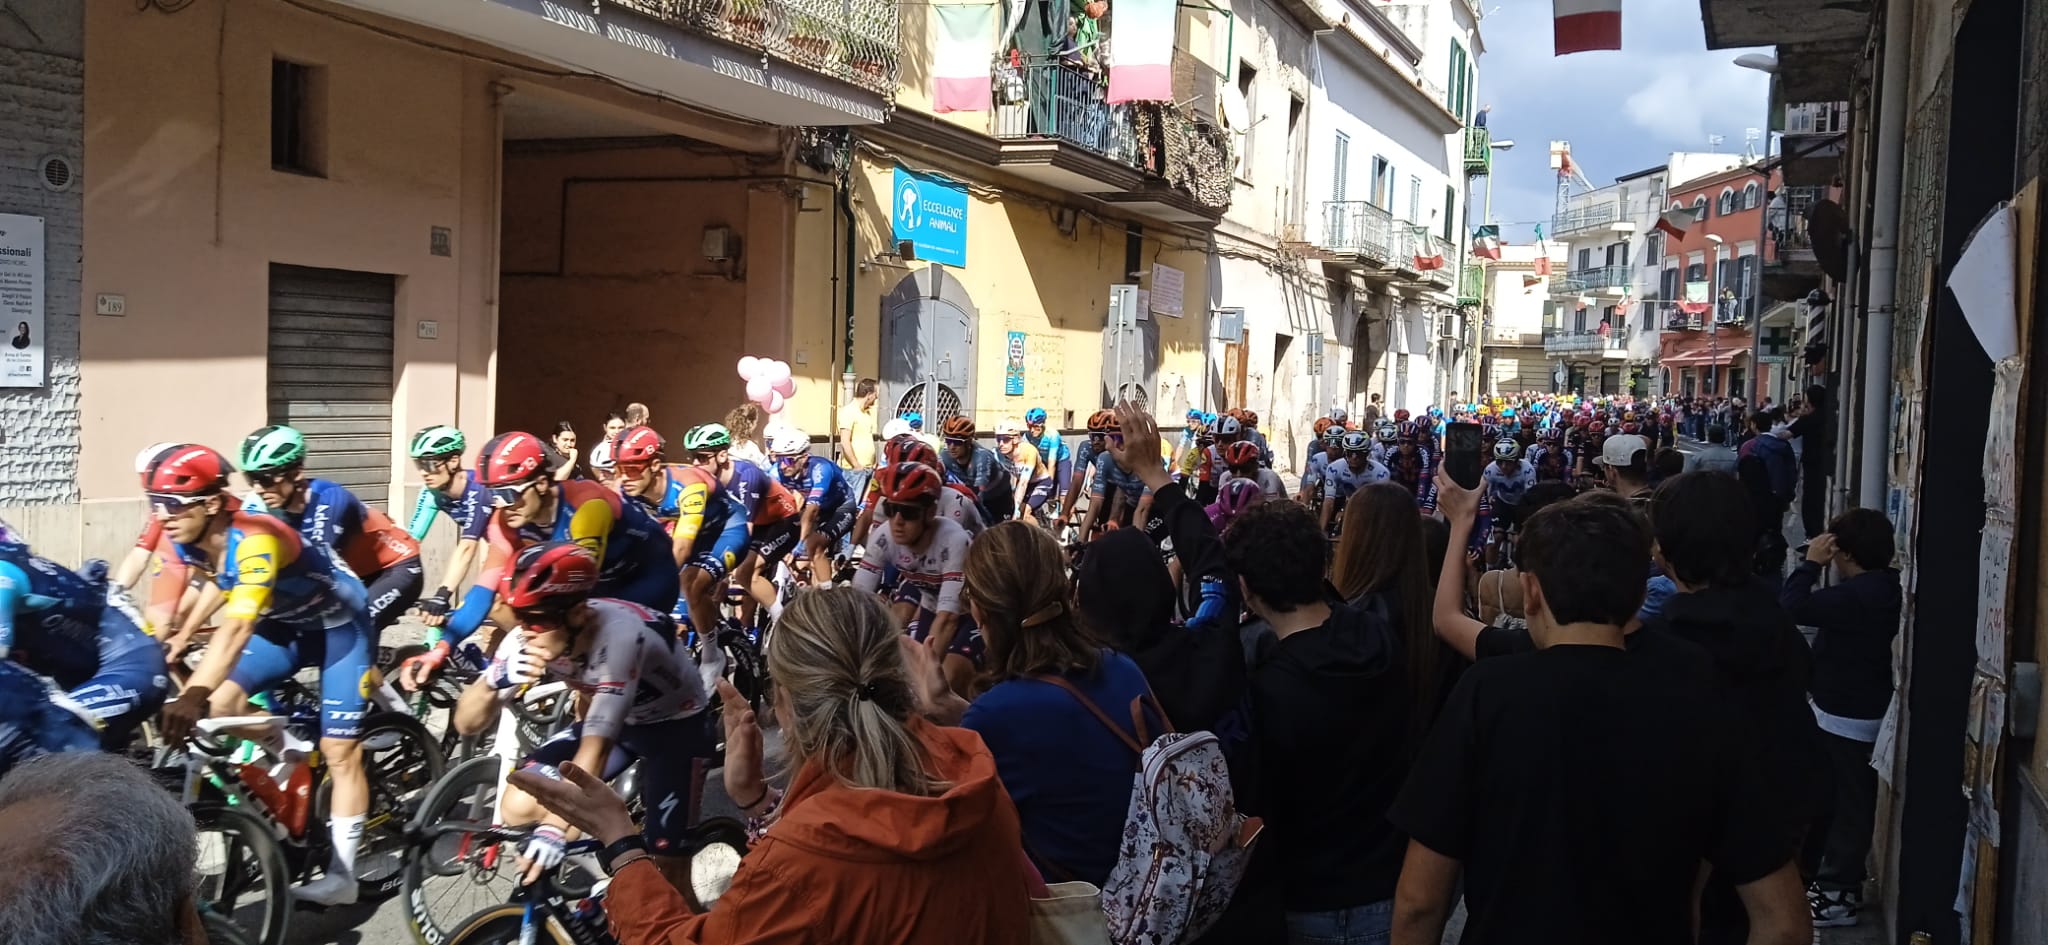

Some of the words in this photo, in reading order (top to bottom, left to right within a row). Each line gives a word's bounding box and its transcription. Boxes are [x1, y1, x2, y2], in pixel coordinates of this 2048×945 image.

[923, 199, 963, 220] ECCELLENZE
[929, 217, 957, 233] ANIMALI
[108, 301, 122, 312] 189
